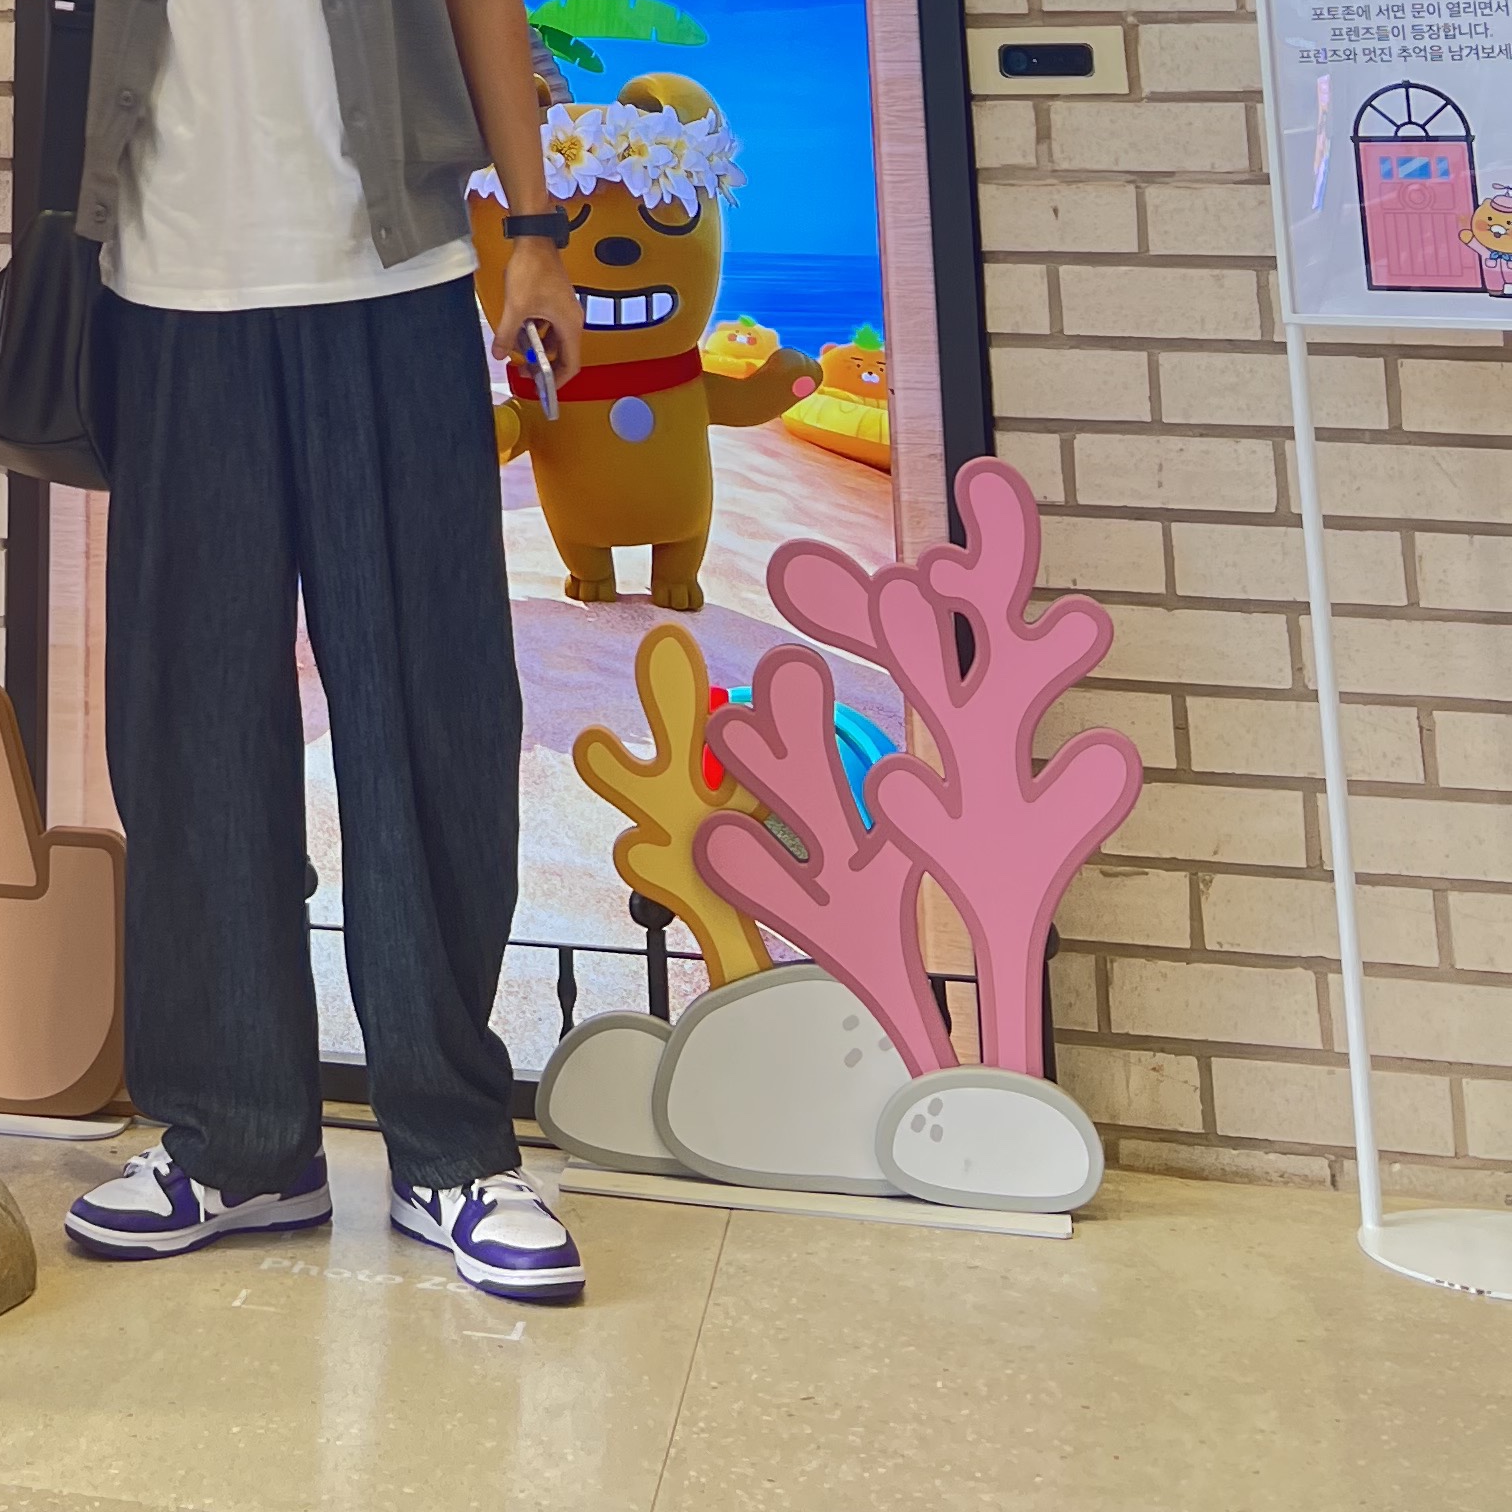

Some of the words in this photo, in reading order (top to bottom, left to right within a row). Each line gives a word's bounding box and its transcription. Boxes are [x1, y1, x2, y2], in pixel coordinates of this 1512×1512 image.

[1311, 4, 1372, 21] 포토존에
[1376, 2, 1406, 20] 서면
[1410, 1, 1441, 19] 문이
[1446, 0, 1510, 18] 열리면서
[1330, 24, 1406, 42] 프렌즈들이
[1410, 21, 1494, 41] 등장합니다.
[1298, 47, 1358, 65] 프렌즈와
[1362, 46, 1393, 63] 멋진
[1397, 44, 1444, 62] 추억을
[1448, 42, 1512, 62] 남겨보세
[259, 1257, 404, 1285] Photo
[415, 1275, 469, 1293] Zo
